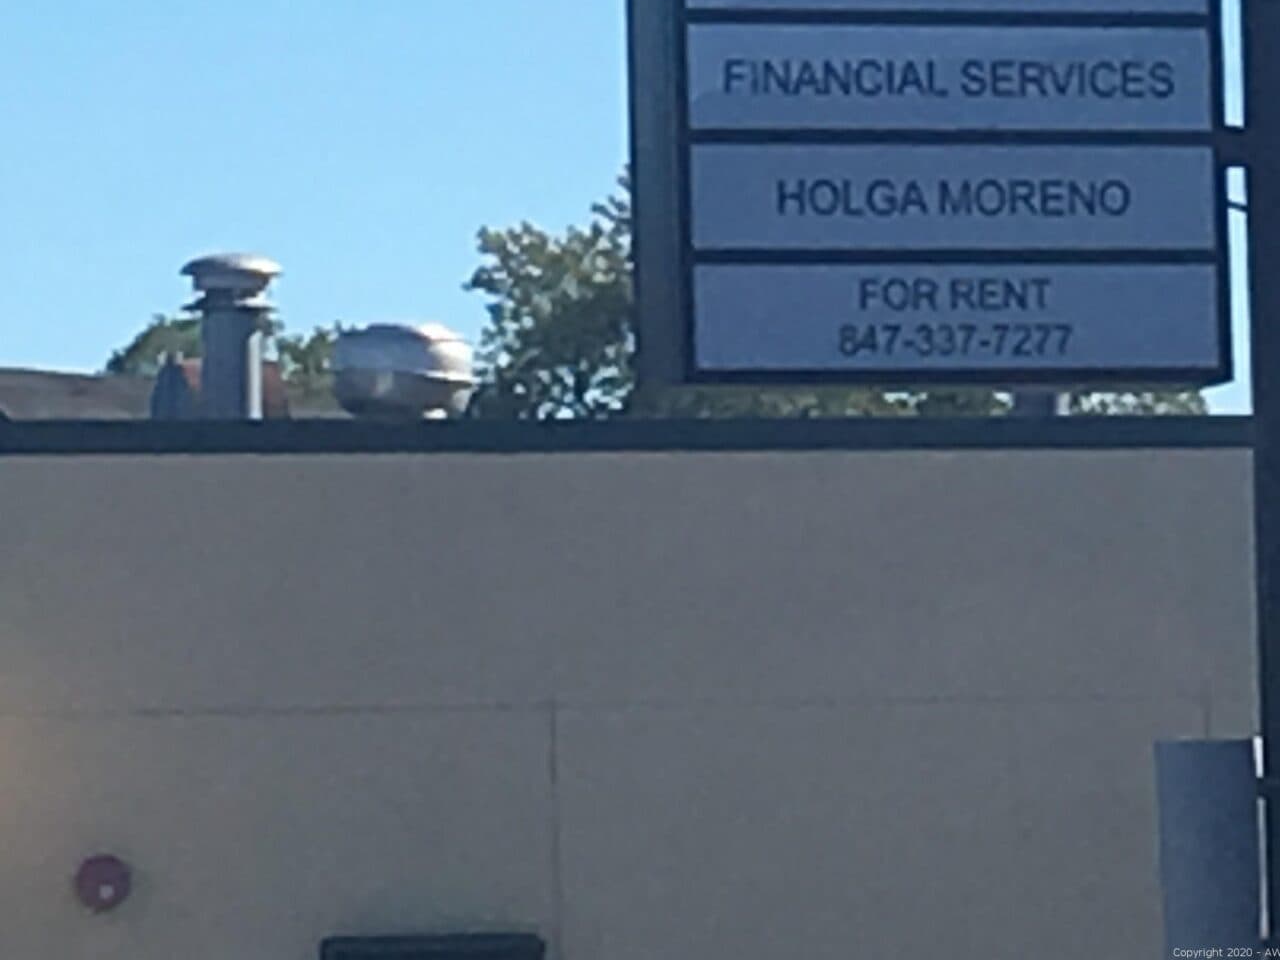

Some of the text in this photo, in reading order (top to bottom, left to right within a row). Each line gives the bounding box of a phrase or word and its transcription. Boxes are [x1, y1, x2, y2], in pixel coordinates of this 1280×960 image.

[723, 59, 1175, 98] FINANCIAL SERVICES
[777, 179, 1132, 217] HOLGA MORENO
[859, 278, 1053, 311] FOR RENT
[838, 323, 1073, 358] 847-337-7277
